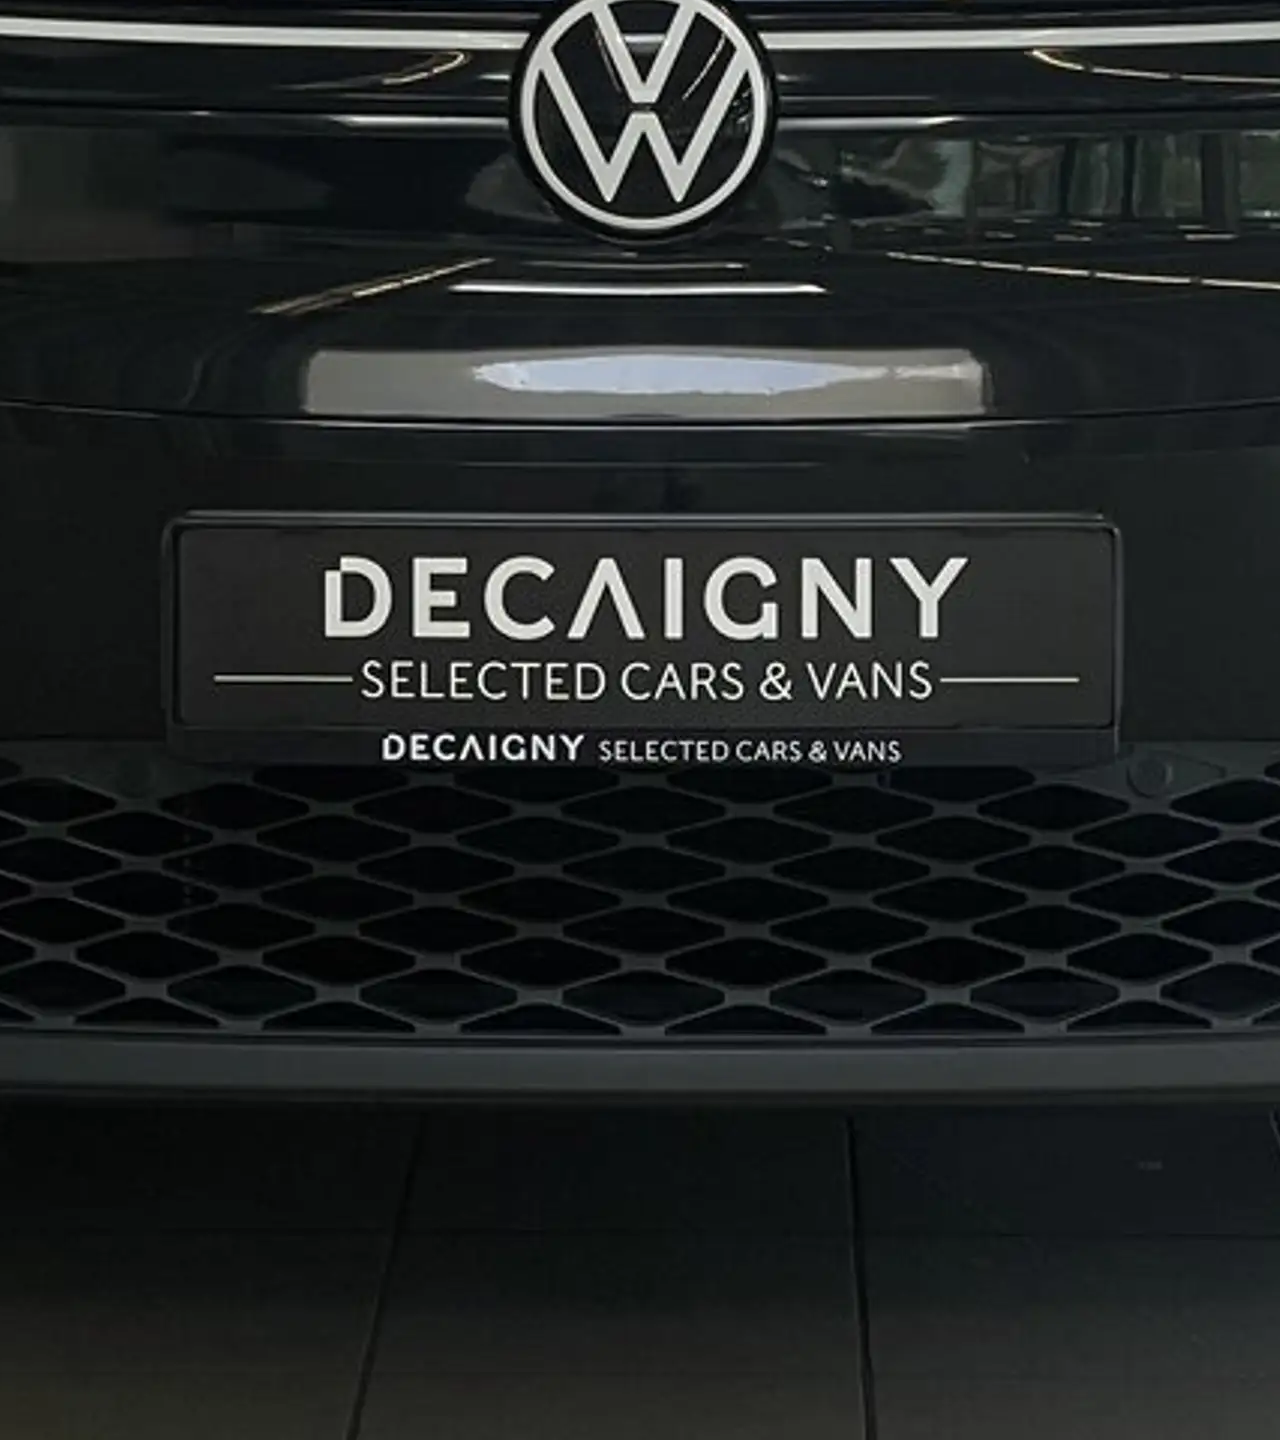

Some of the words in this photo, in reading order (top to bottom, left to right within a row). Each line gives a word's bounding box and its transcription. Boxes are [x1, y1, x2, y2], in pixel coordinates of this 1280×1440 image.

[324, 555, 969, 641] DECAIGNY
[360, 659, 606, 701] SELECTED
[620, 661, 745, 702] CARS
[758, 661, 793, 701] &
[805, 661, 934, 701] VANS
[381, 732, 586, 762] DECAIGNY
[598, 739, 729, 763] SELECTED
[734, 739, 803, 763] CARS
[807, 739, 827, 763] &
[832, 739, 902, 763] VANS
